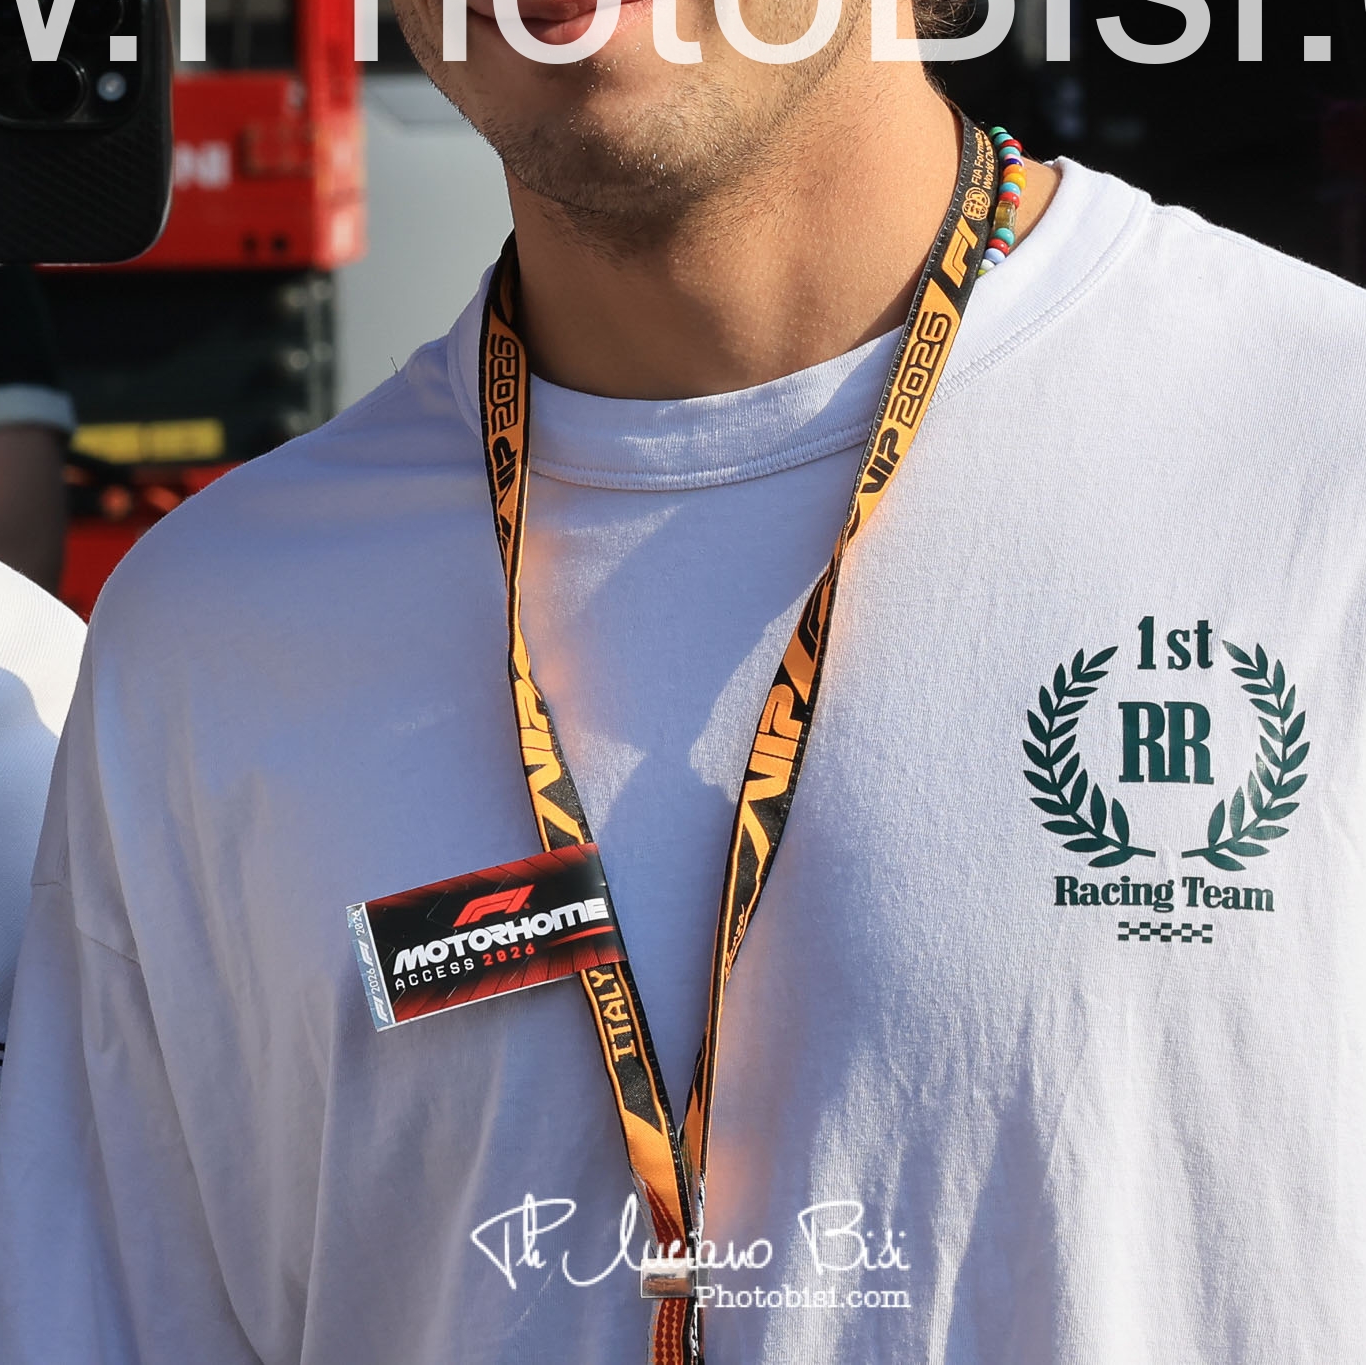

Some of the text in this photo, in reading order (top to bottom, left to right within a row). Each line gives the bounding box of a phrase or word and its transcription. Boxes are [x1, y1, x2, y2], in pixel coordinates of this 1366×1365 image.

[489, 333, 519, 432] 2026
[860, 310, 953, 495] VIP 2026
[492, 436, 520, 509] VIP
[1137, 615, 1214, 671] 1st
[515, 678, 562, 794] VIP
[744, 684, 804, 802] VIP
[1118, 701, 1215, 785] RR
[1054, 875, 1275, 913] Racing Team
[392, 897, 610, 976] MOTORHOME
[395, 942, 536, 991] ACCESS 2026
[366, 968, 381, 995] 2026
[591, 969, 637, 1063] ITALY
